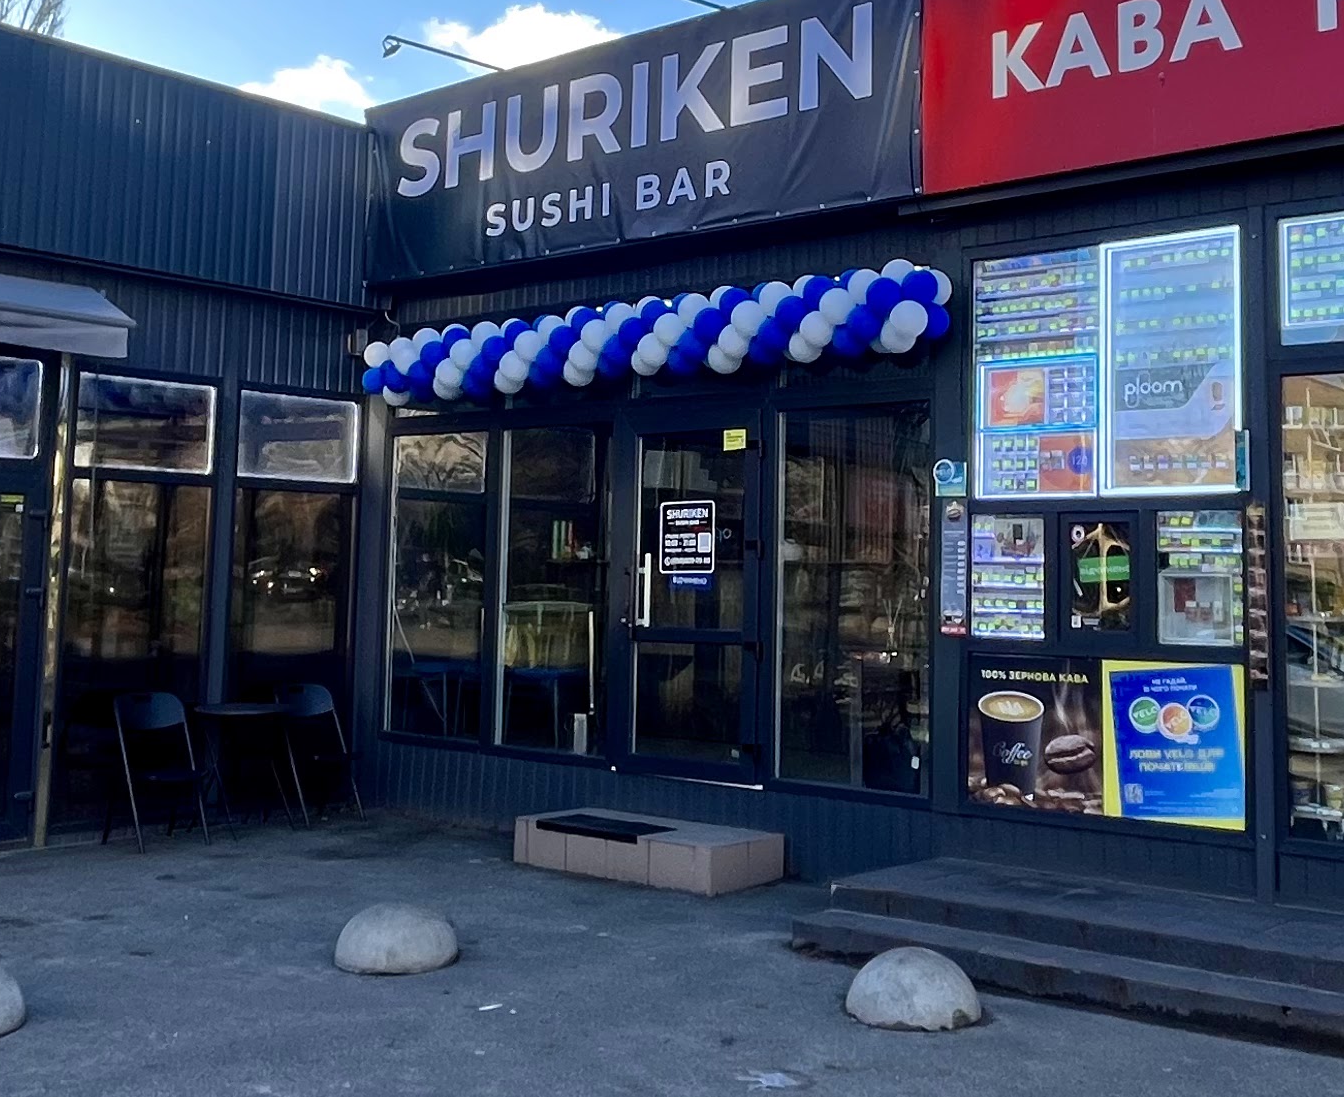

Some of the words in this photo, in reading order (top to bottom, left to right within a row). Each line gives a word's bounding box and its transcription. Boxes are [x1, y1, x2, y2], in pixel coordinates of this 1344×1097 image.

[396, 1, 874, 198] SHURIKEN
[485, 181, 612, 238] SUSHI
[634, 160, 733, 211] BAR
[1124, 371, 1183, 408] ploom
[981, 669, 1006, 680] 100%
[1009, 671, 1057, 682] ЗЕРНОВА
[1058, 673, 1089, 683] КАВА
[992, 741, 1033, 764] Coffee
